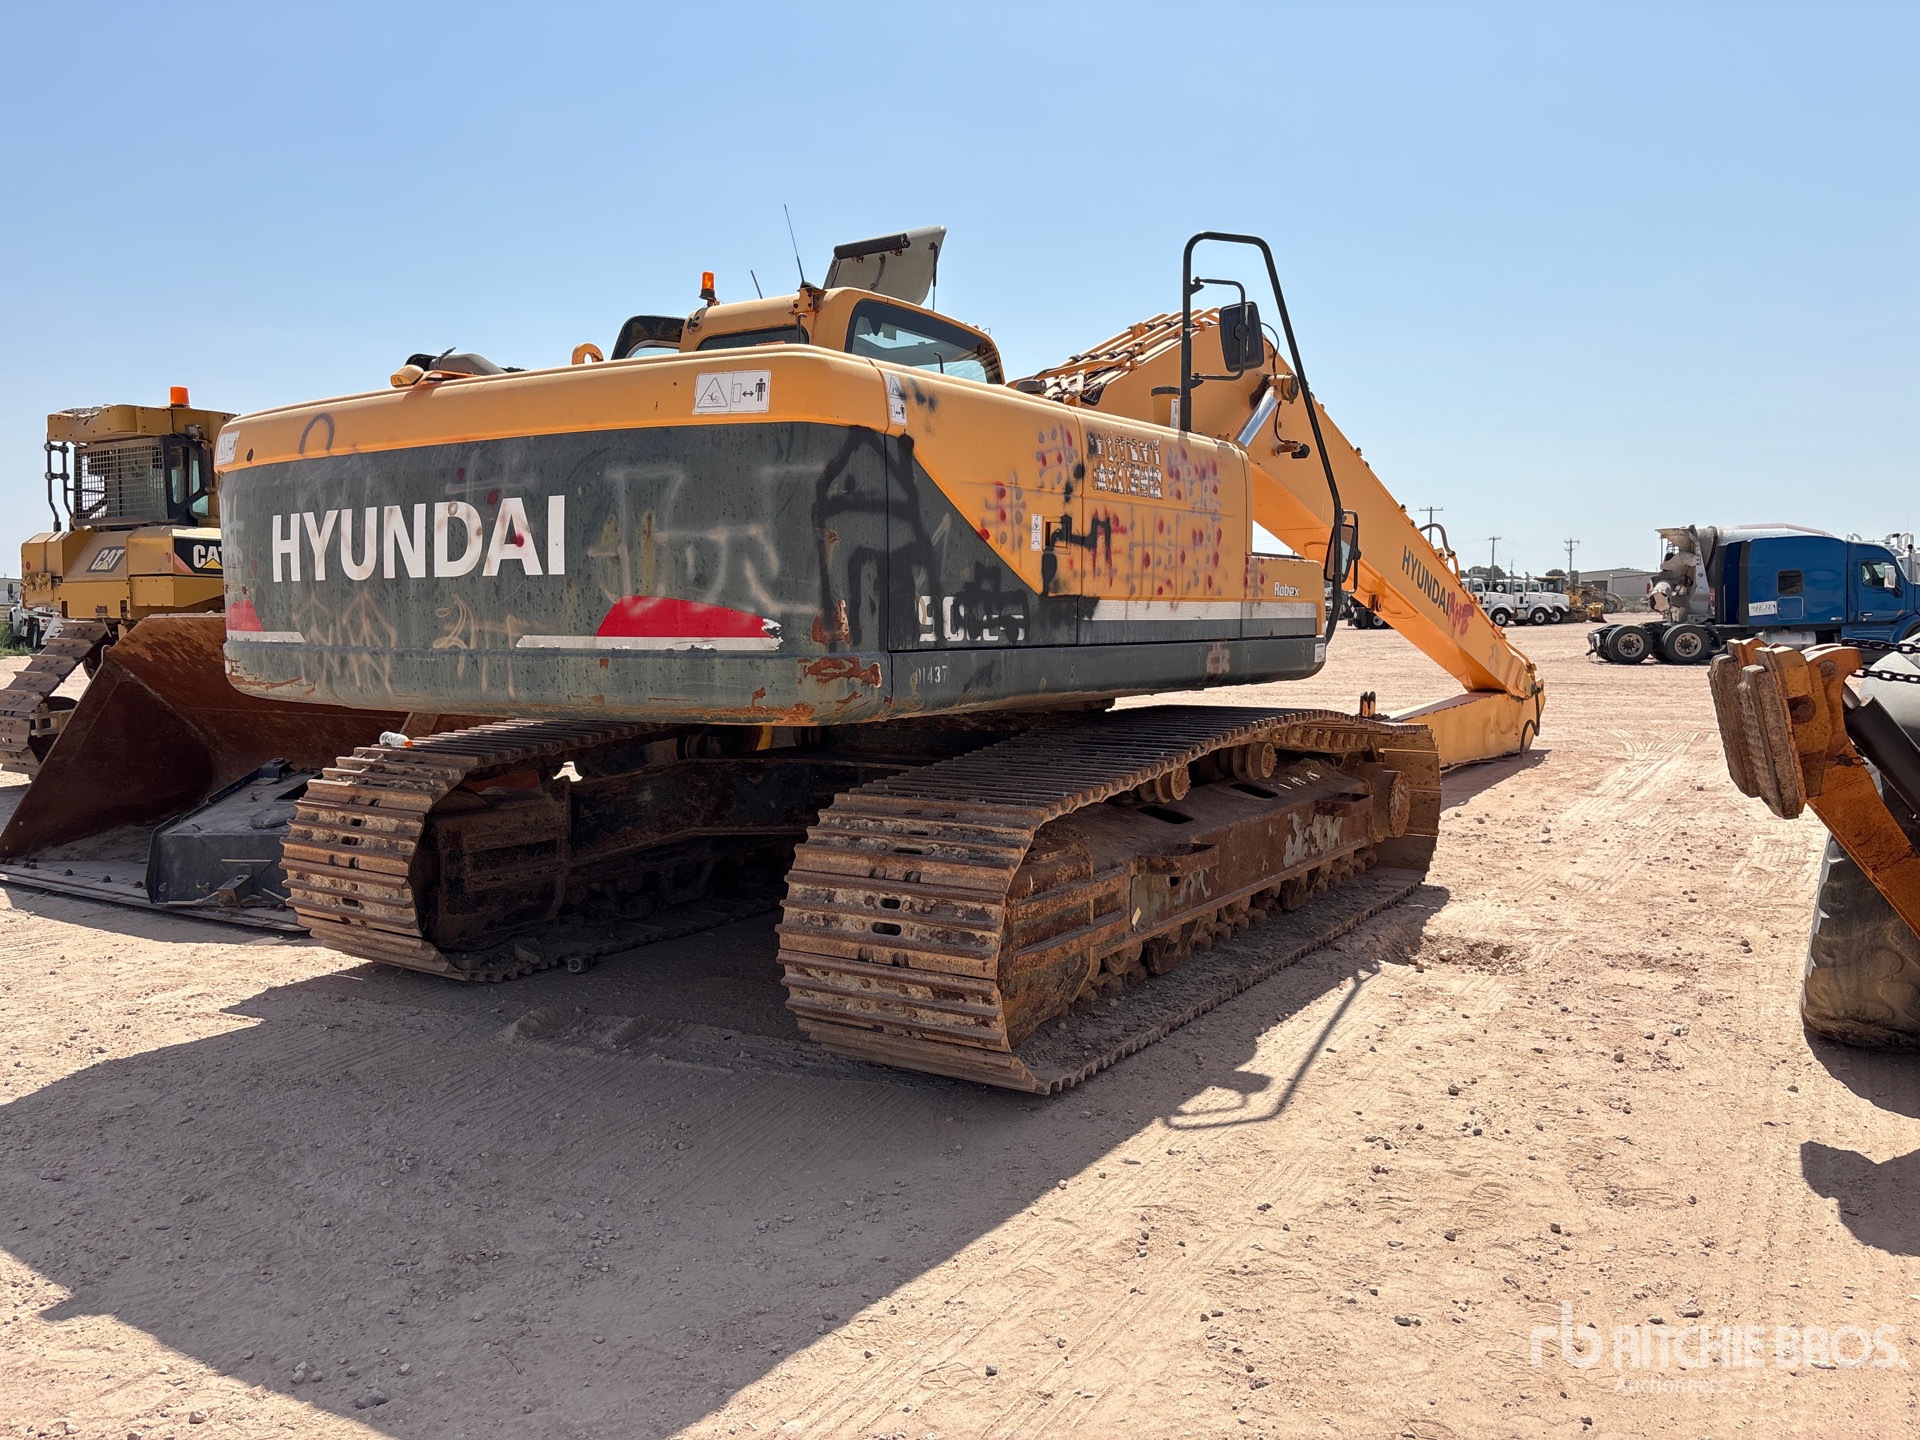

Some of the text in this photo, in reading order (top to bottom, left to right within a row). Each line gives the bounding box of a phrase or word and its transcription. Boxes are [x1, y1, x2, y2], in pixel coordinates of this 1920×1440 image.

[272, 494, 565, 583] HYUNDAI
[90, 547, 125, 571] CAT
[192, 543, 222, 569] CA
[1274, 582, 1300, 597] Robex
[1402, 545, 1451, 616] HYUNDAI
